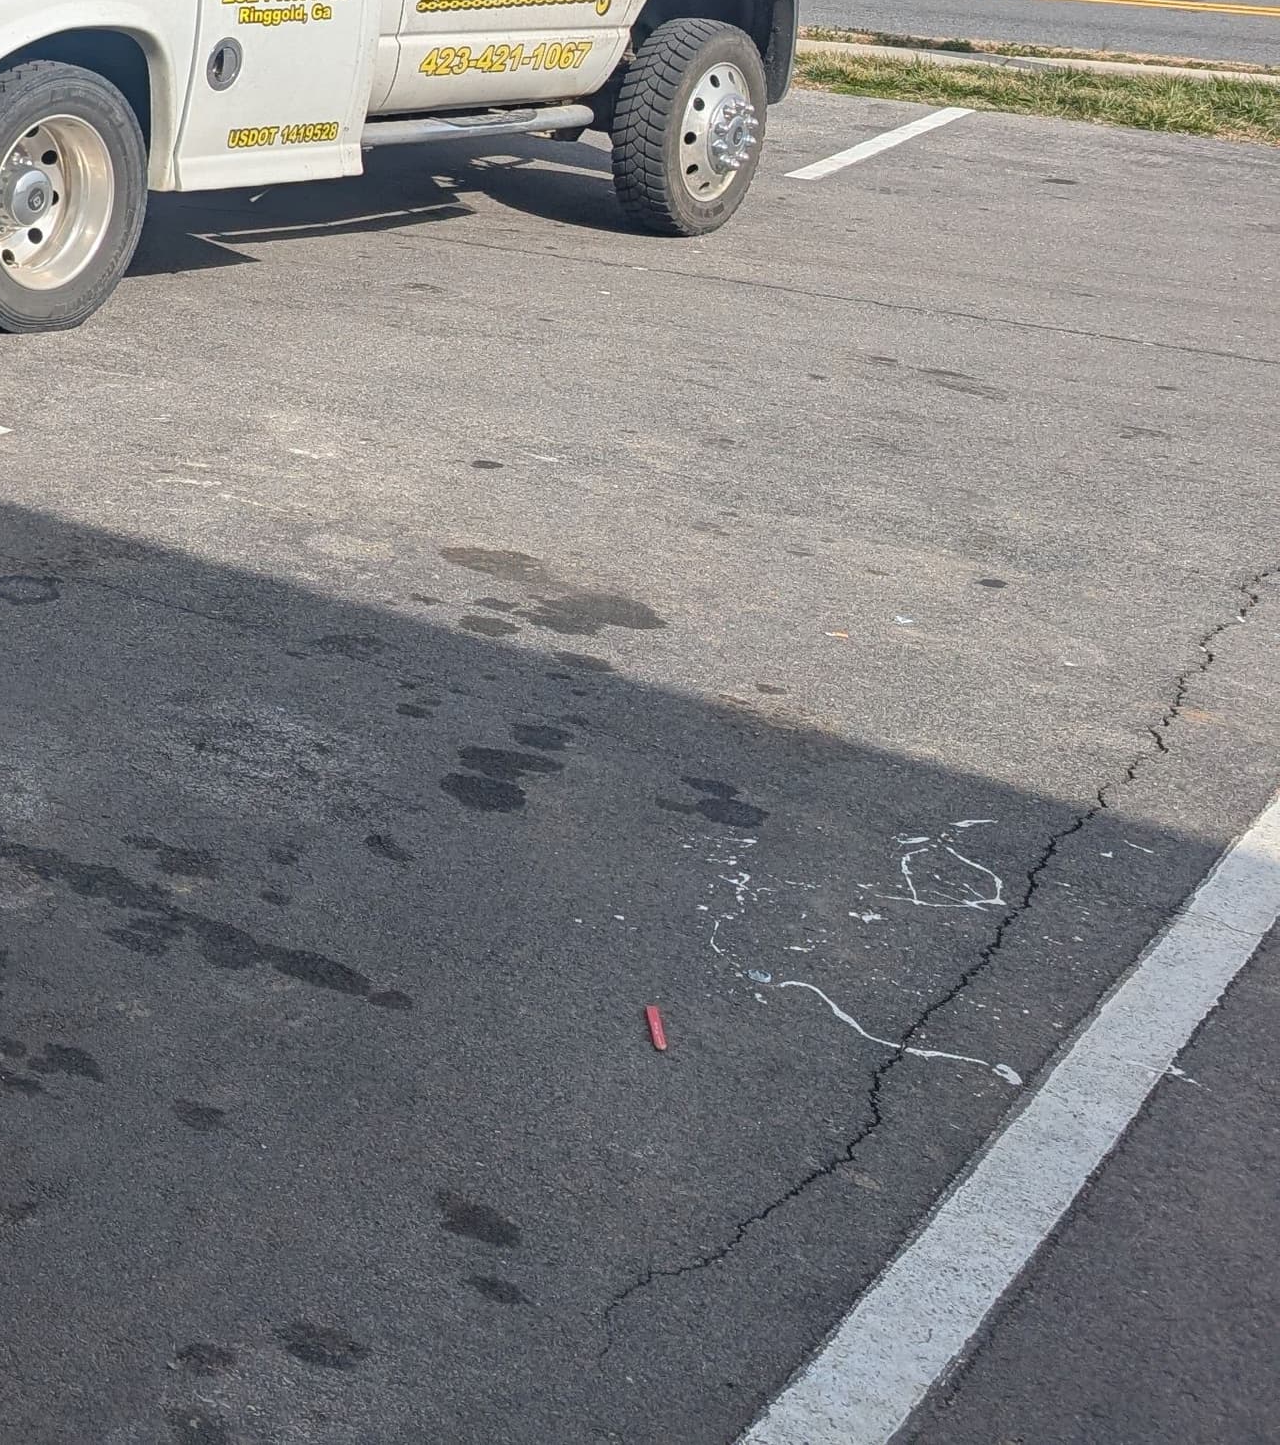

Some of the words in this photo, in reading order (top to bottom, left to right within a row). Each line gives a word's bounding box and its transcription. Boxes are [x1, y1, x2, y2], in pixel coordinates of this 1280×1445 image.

[238, 4, 308, 26] Ringgold,
[311, 5, 332, 20] Ga
[419, 41, 593, 76] 423-421-1067
[228, 126, 280, 148] USDOT
[281, 121, 339, 145] 1419528
